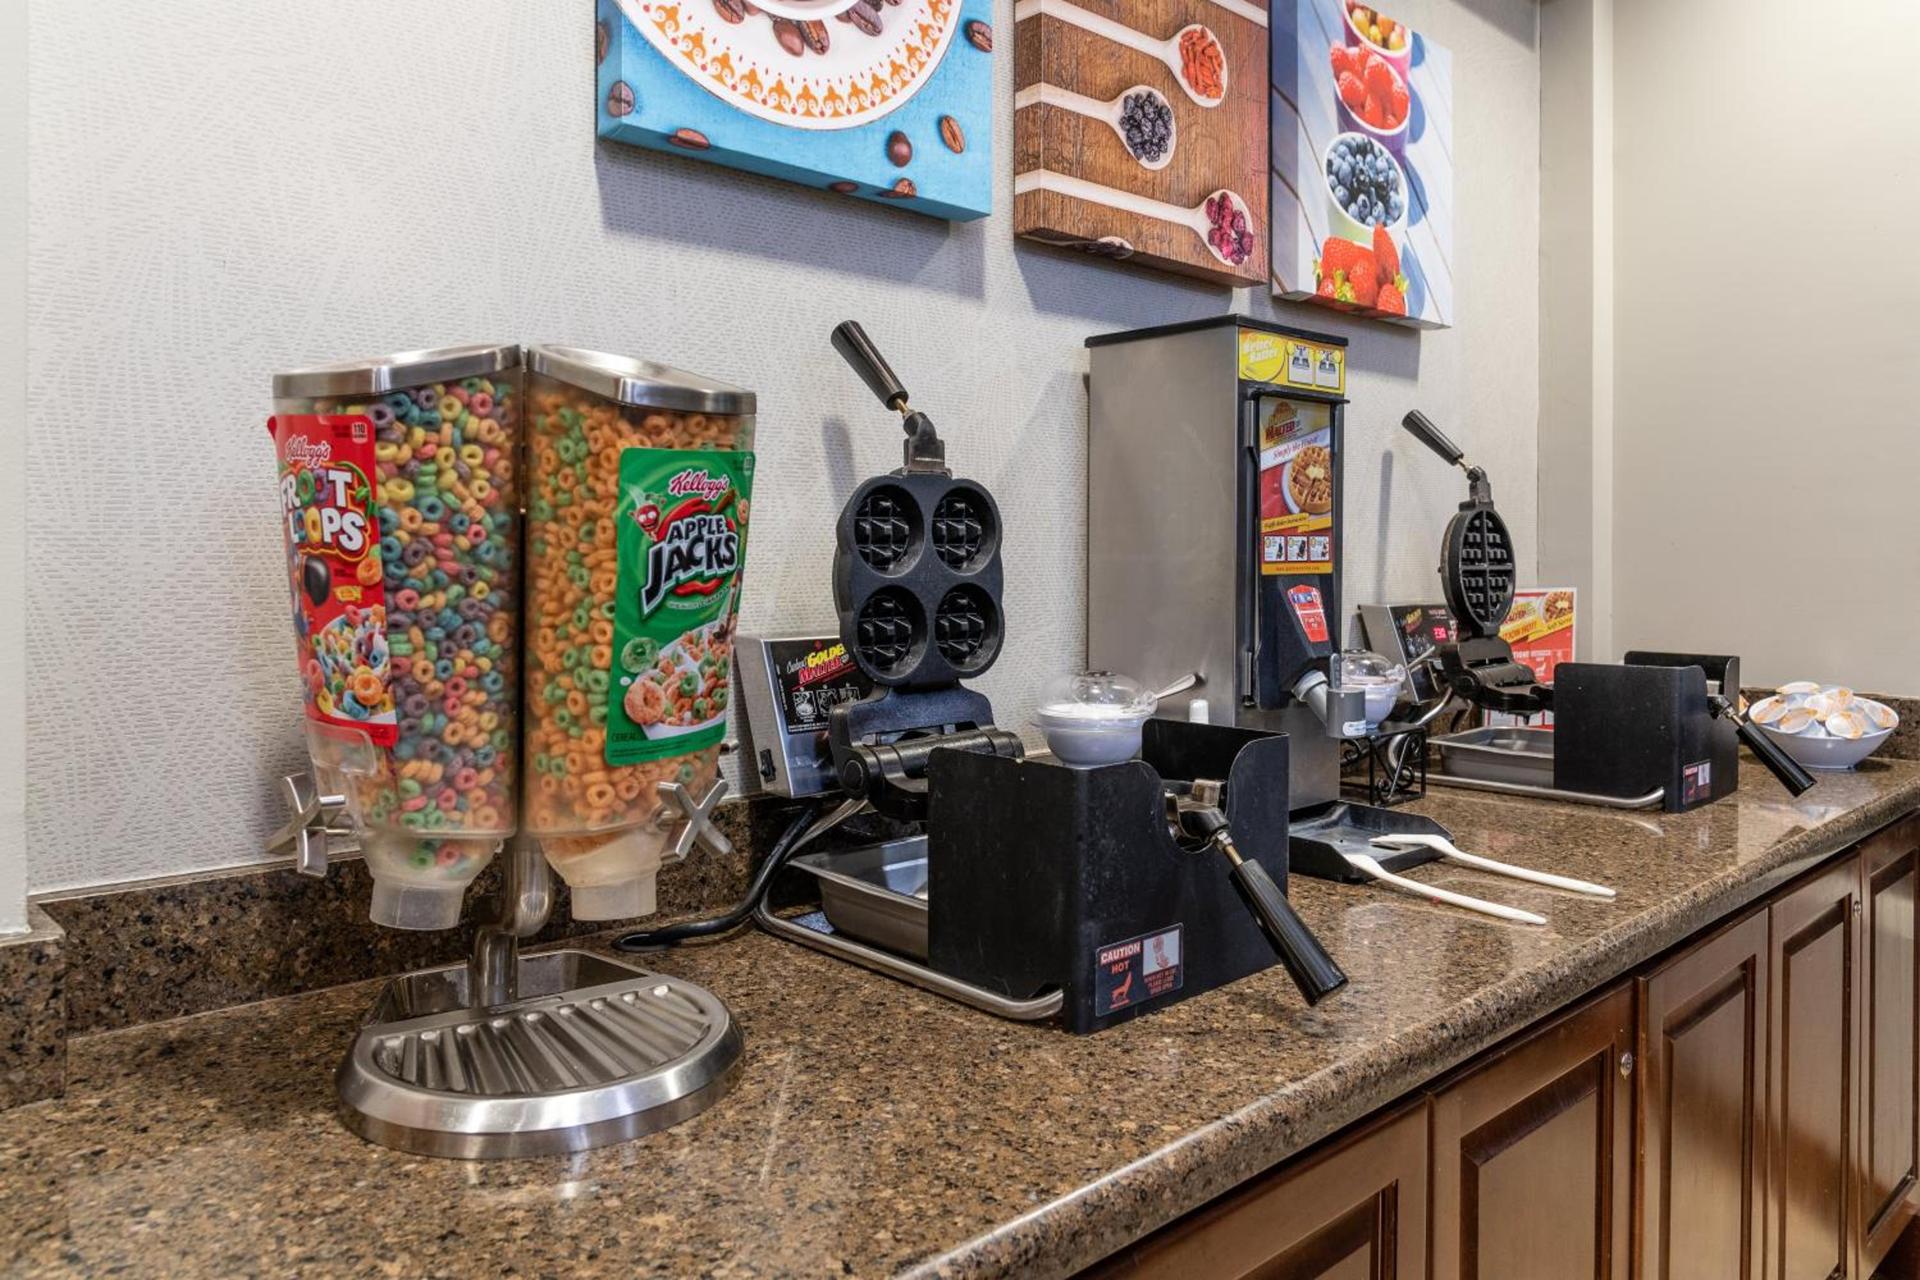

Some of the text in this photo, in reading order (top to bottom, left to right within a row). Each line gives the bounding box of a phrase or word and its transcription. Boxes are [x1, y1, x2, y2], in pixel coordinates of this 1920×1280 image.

[668, 469, 730, 500] Kellogg's
[288, 506, 365, 551] LOOPS
[666, 516, 725, 544] APPLE
[642, 534, 738, 610] JACKS
[1101, 941, 1141, 964] CAUTION
[1111, 960, 1130, 975] HOT
